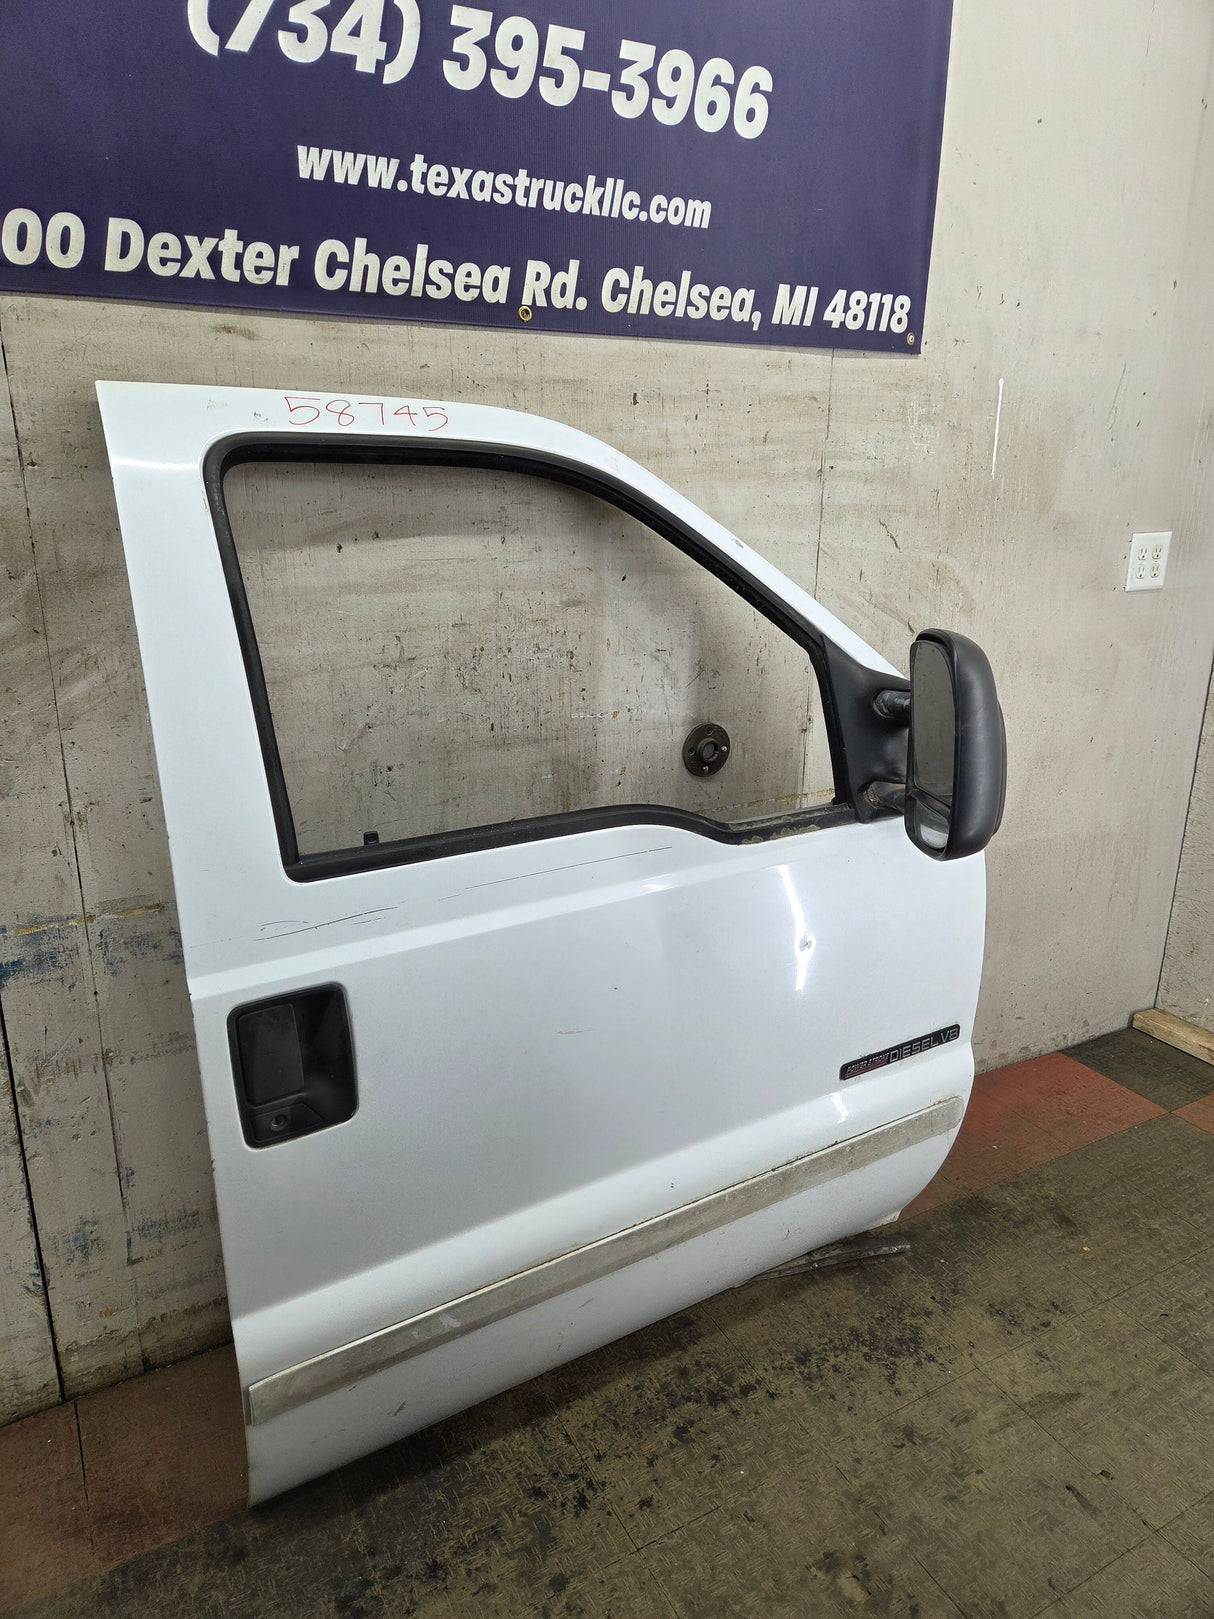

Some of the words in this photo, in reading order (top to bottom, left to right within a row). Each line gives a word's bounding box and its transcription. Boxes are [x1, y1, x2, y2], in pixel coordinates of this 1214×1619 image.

[187, 0, 421, 85] (734)
[442, 4, 774, 140] 395-3966
[297, 144, 712, 229] www.texastruckllc.com
[1, 207, 86, 269] 00
[104, 217, 300, 287] Dexter
[314, 236, 511, 304] Chelsea
[521, 258, 588, 311] Rd.
[601, 265, 762, 332] Chelsea,
[770, 283, 820, 327] MI
[822, 288, 912, 334] 48118
[284, 396, 449, 431] 58745
[889, 1036, 939, 1063] DIESEL
[940, 1027, 959, 1043] V8
